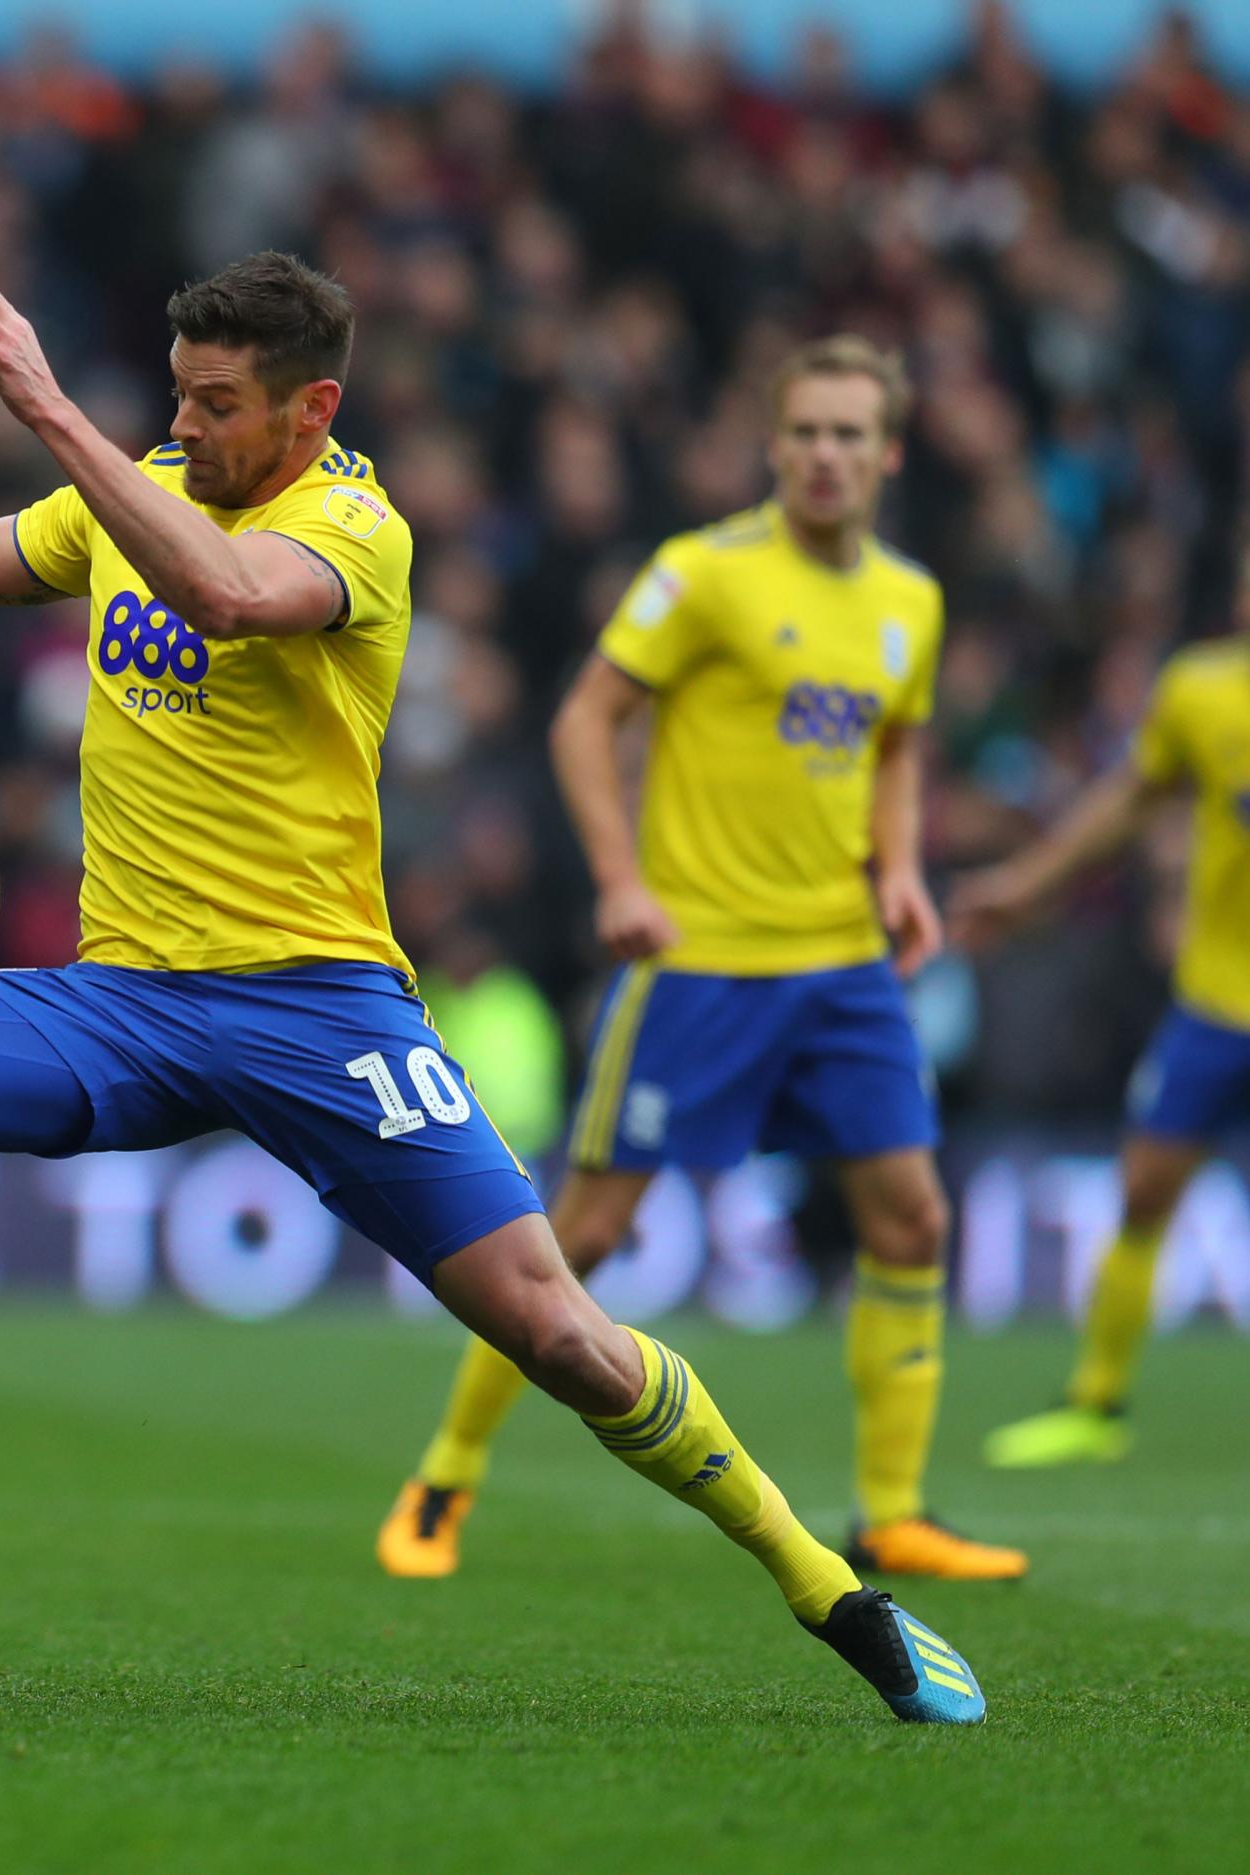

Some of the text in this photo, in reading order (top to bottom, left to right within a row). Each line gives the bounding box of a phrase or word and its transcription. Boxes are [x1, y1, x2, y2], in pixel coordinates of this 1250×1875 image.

[99, 590, 209, 684] 888
[121, 687, 211, 717] sport
[345, 1046, 471, 1139] 10
